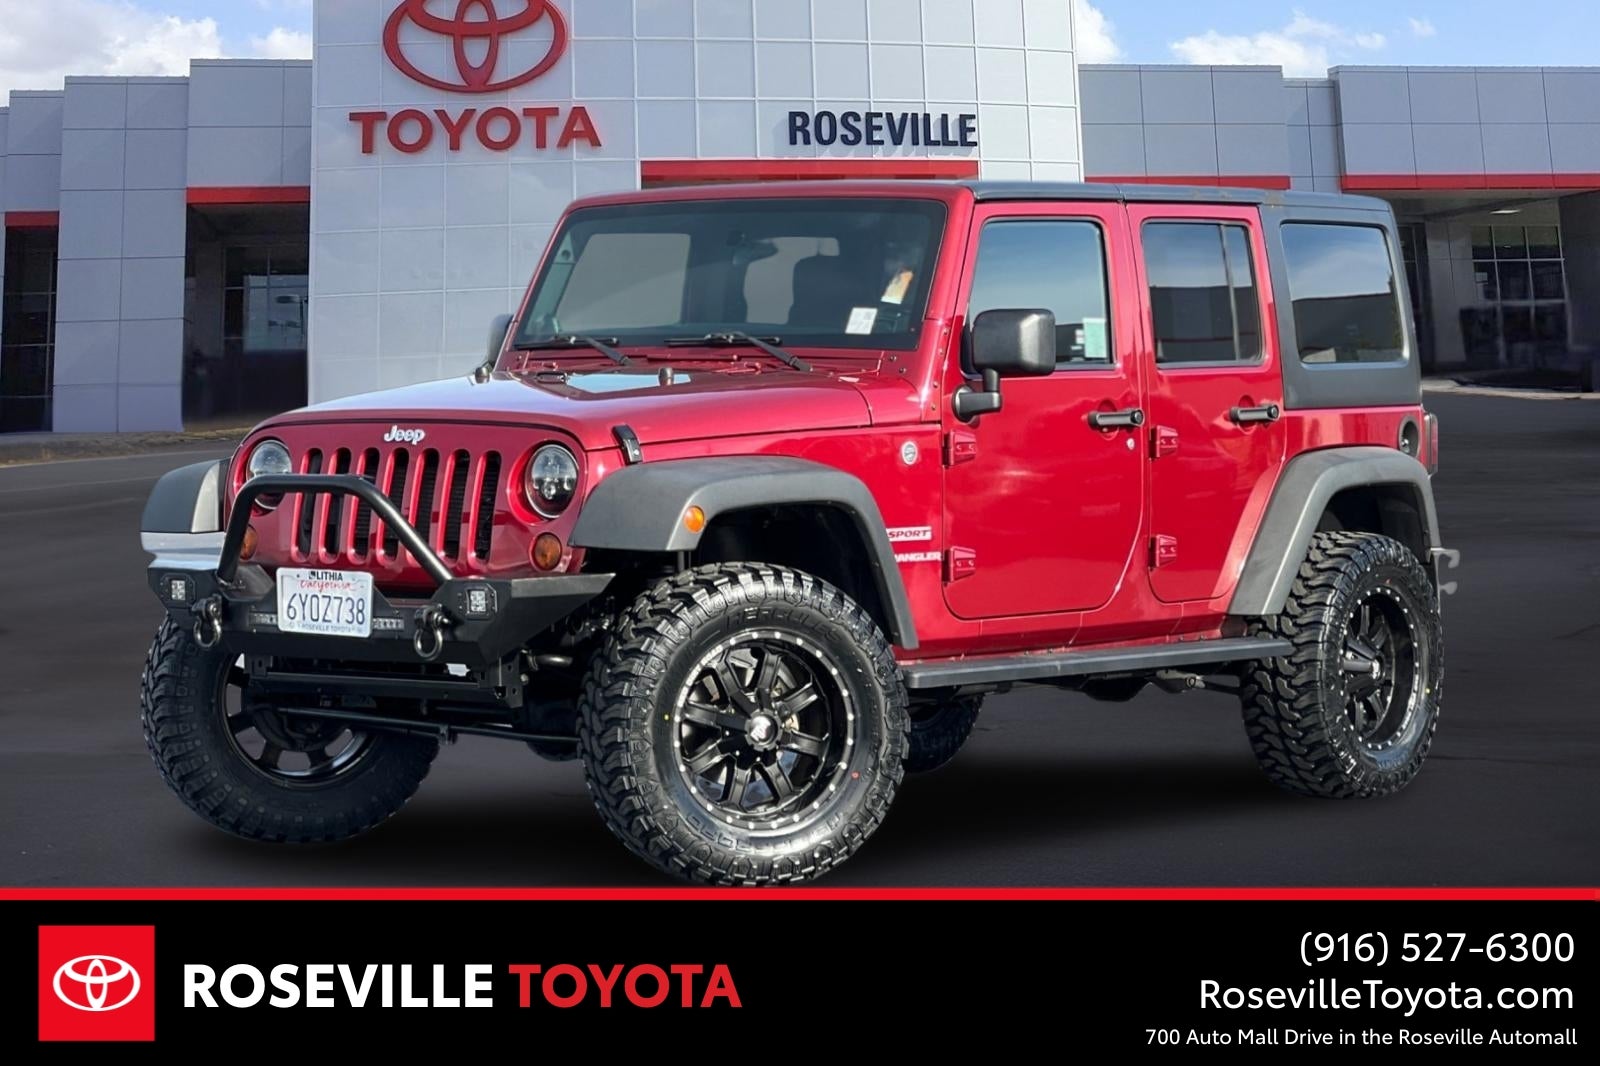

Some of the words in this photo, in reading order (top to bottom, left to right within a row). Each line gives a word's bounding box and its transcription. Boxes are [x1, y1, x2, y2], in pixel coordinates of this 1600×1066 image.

[349, 106, 602, 153] TOYOTA
[788, 110, 978, 147] ROSEVILLE
[383, 424, 426, 446] Jeep
[888, 529, 930, 539] SPORT
[894, 551, 942, 563] ANGLER
[316, 571, 343, 581] LITHIA
